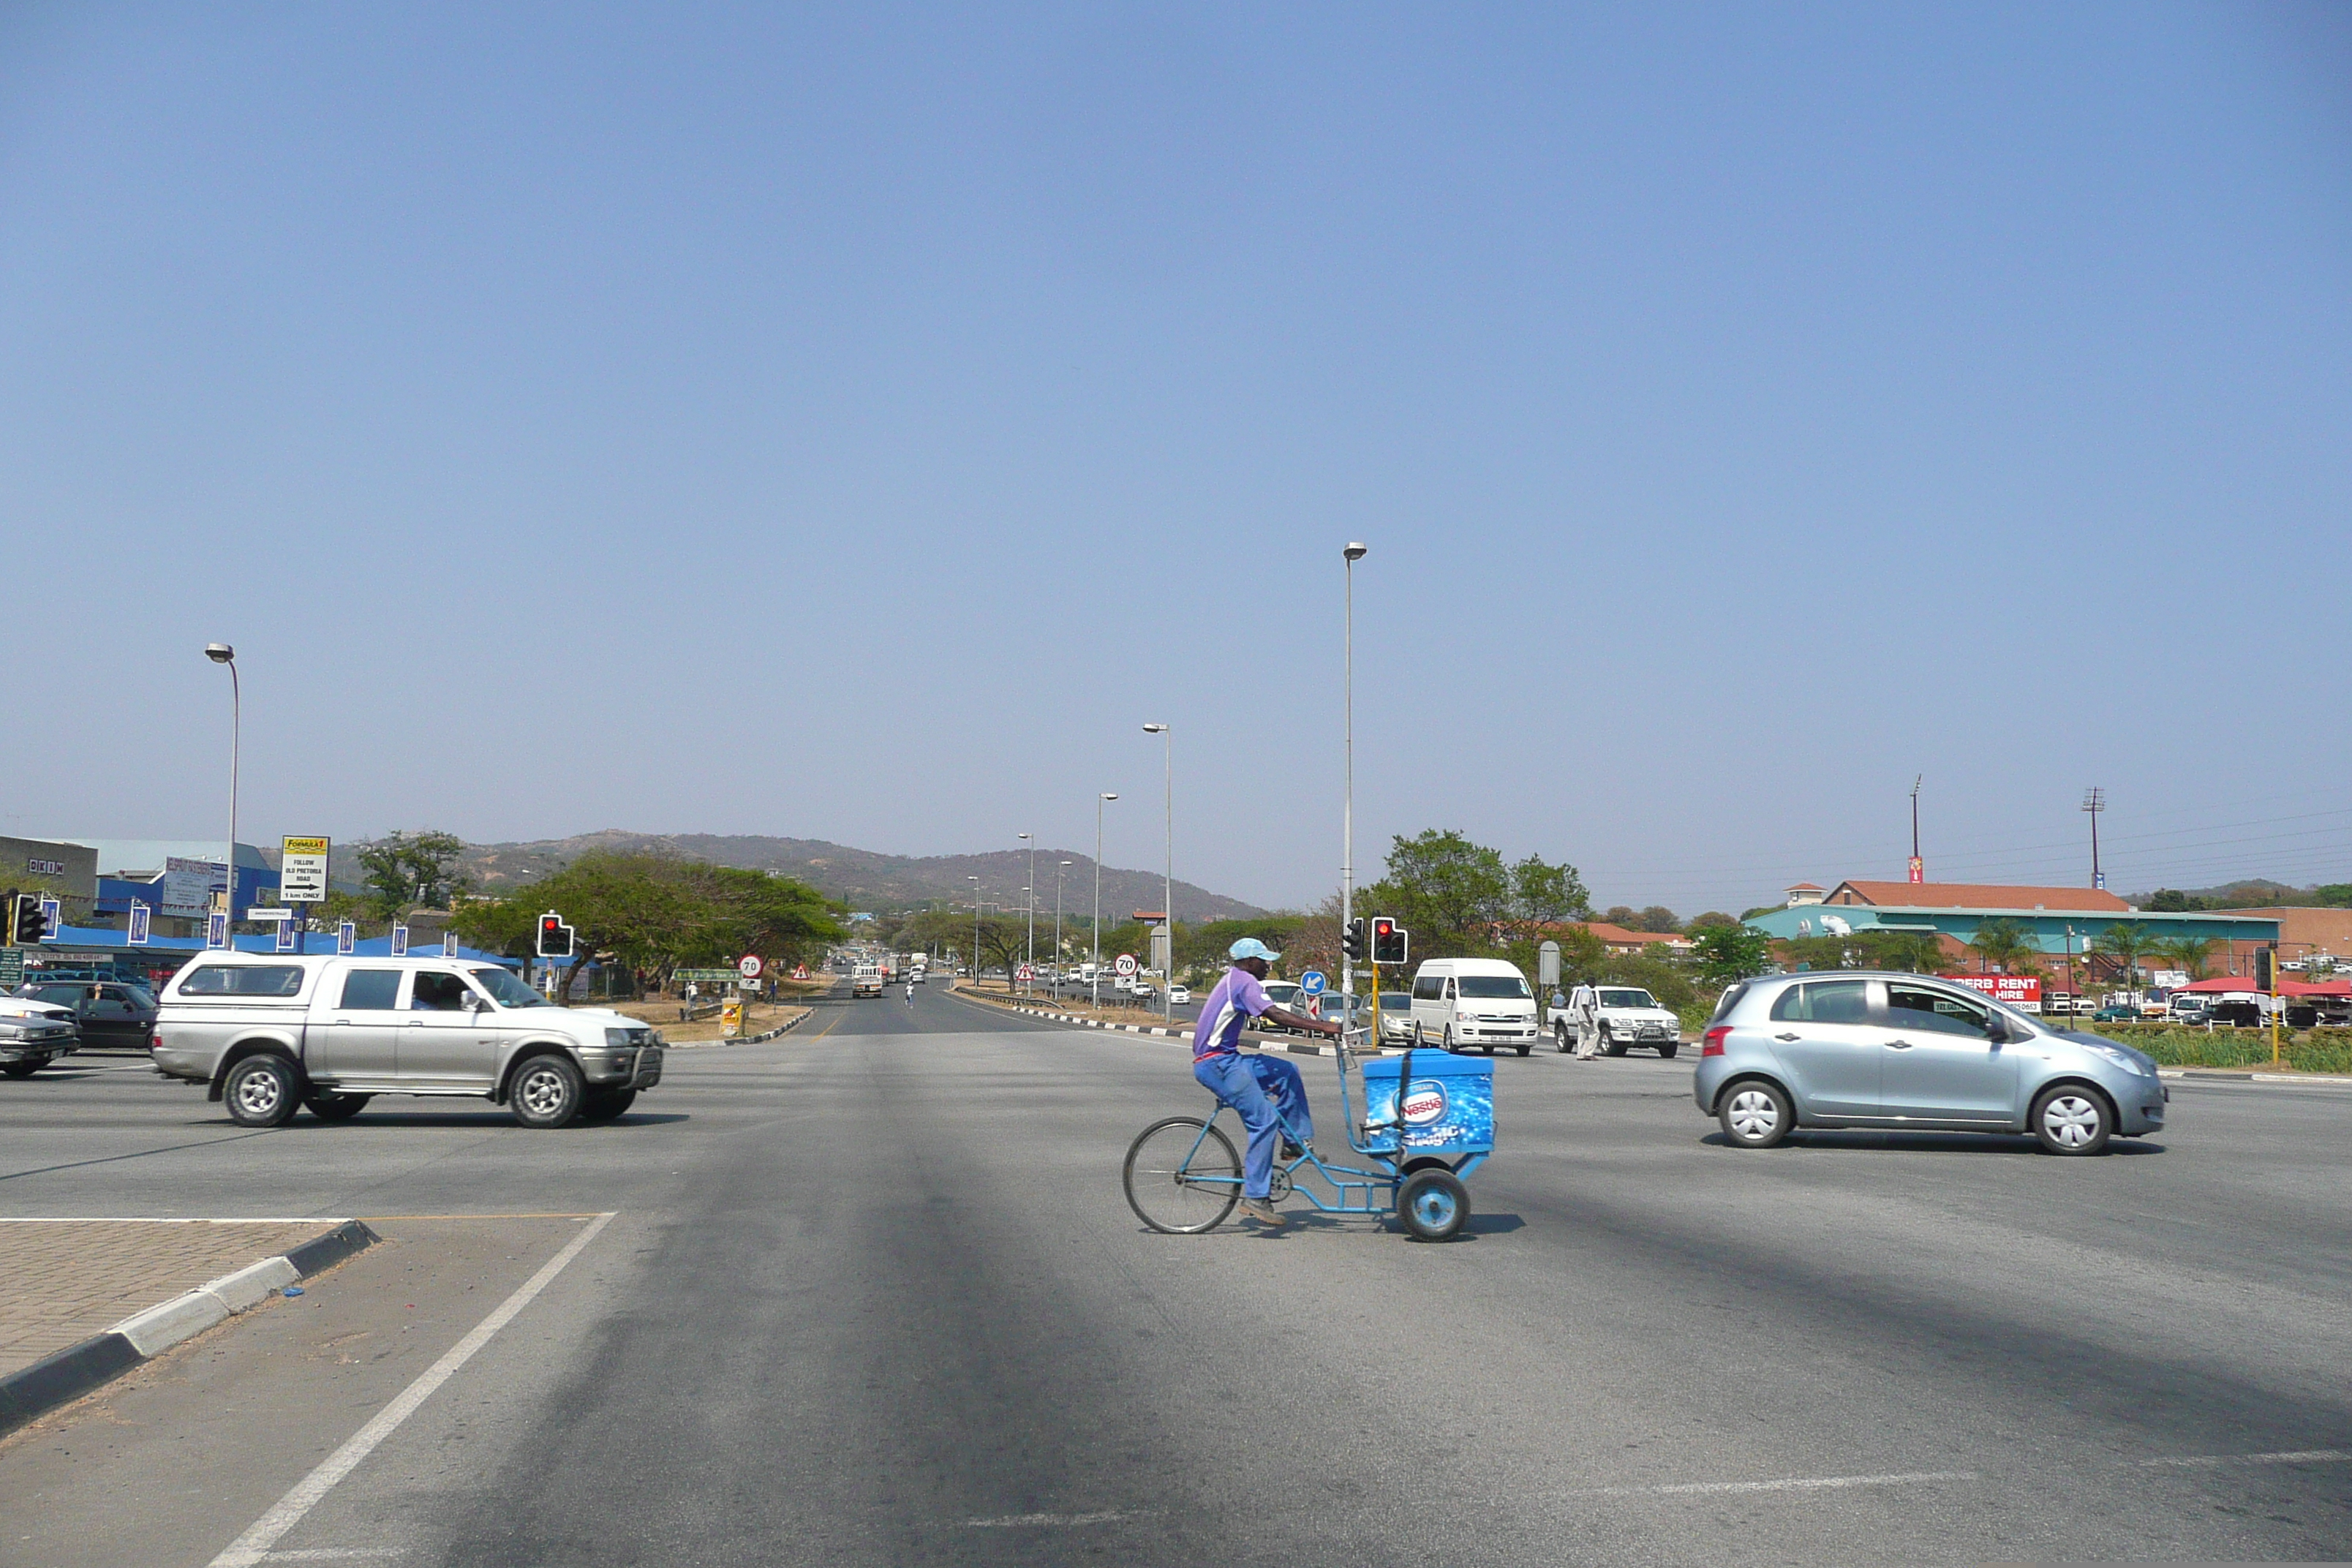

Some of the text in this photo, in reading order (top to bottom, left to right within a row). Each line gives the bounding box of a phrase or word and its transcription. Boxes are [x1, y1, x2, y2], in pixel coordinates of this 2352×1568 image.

[744, 962, 756, 971] 70
[1118, 959, 1133, 970] 70
[1998, 978, 2038, 990] RENT
[1995, 990, 2024, 1000] HIRE
